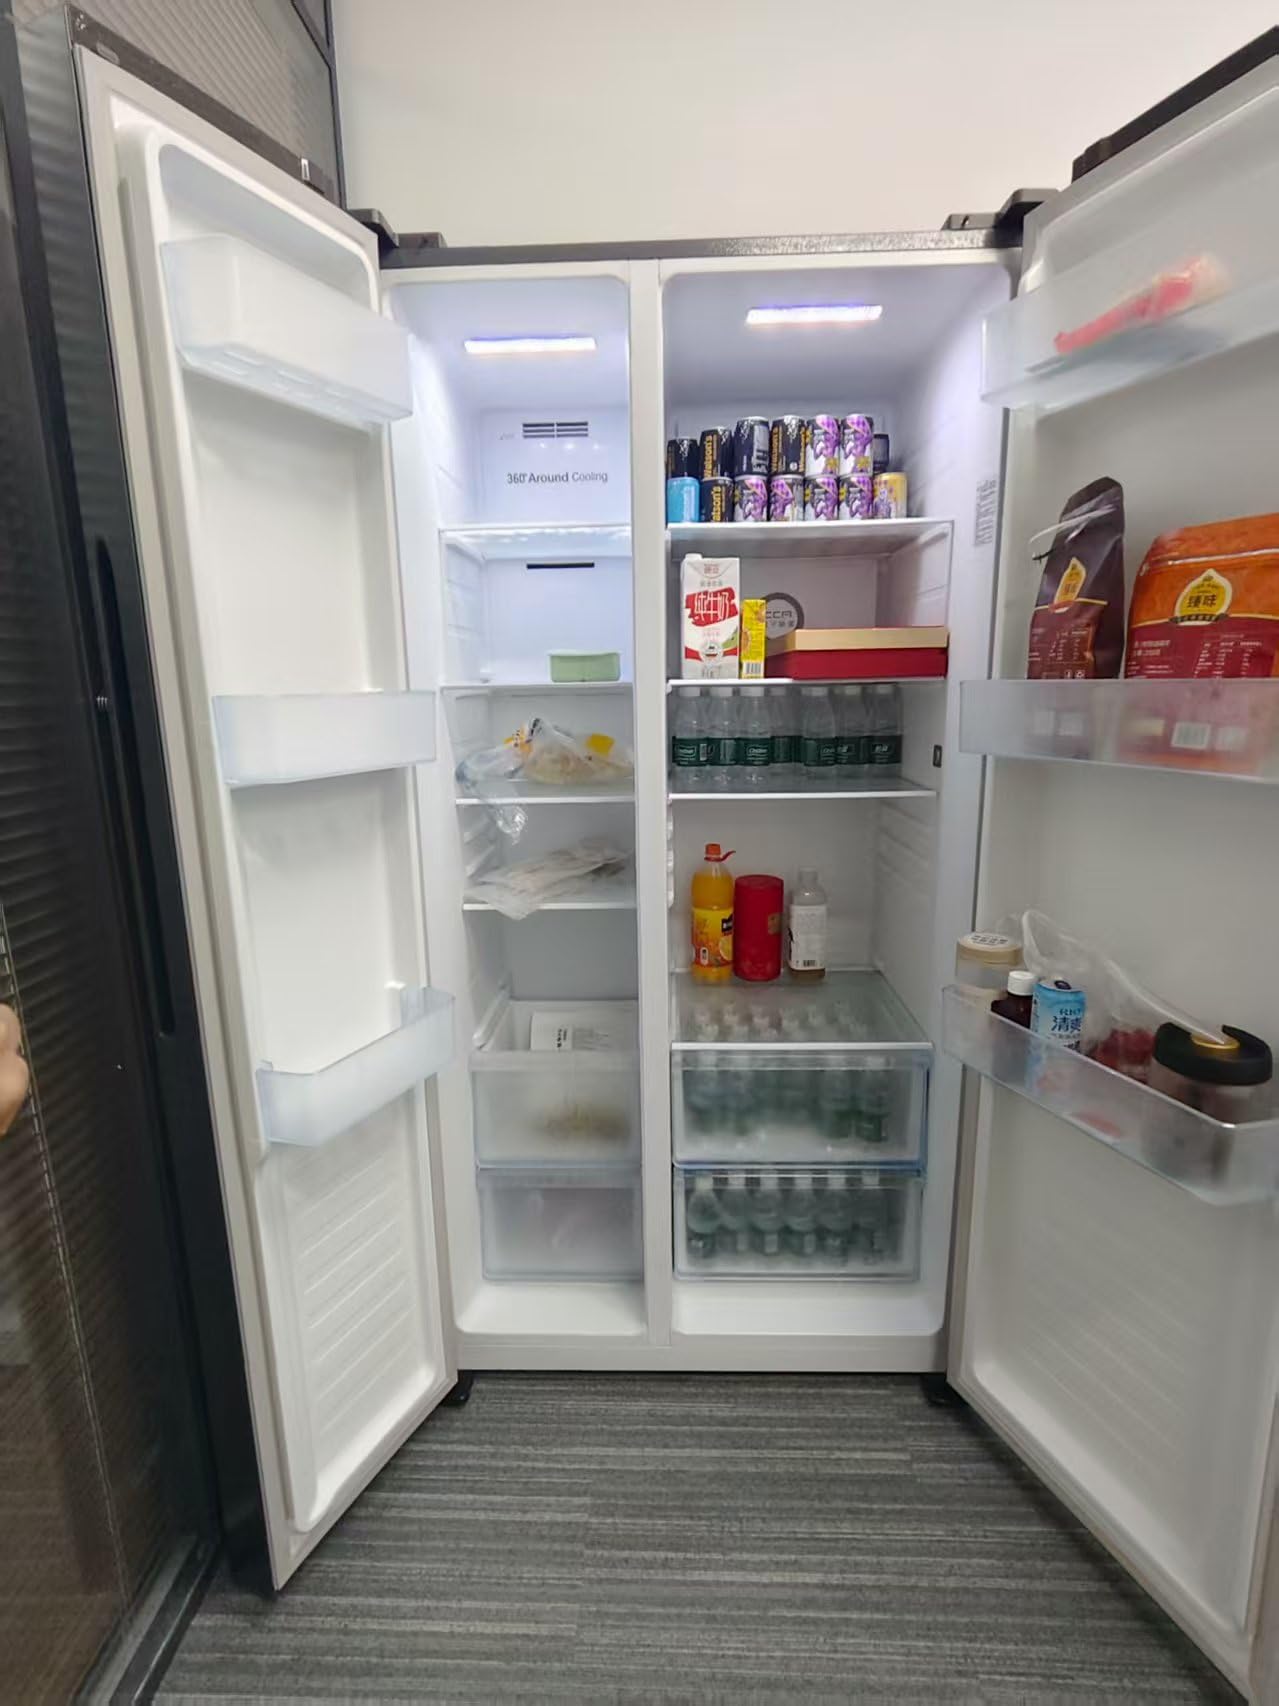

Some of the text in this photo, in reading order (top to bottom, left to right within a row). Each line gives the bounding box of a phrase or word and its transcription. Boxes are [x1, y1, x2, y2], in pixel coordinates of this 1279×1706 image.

[528, 471, 569, 484] Around
[571, 471, 608, 484] Cooling
[694, 590, 729, 621] 纯牛奶
[1051, 1015, 1081, 1033] 清爽
